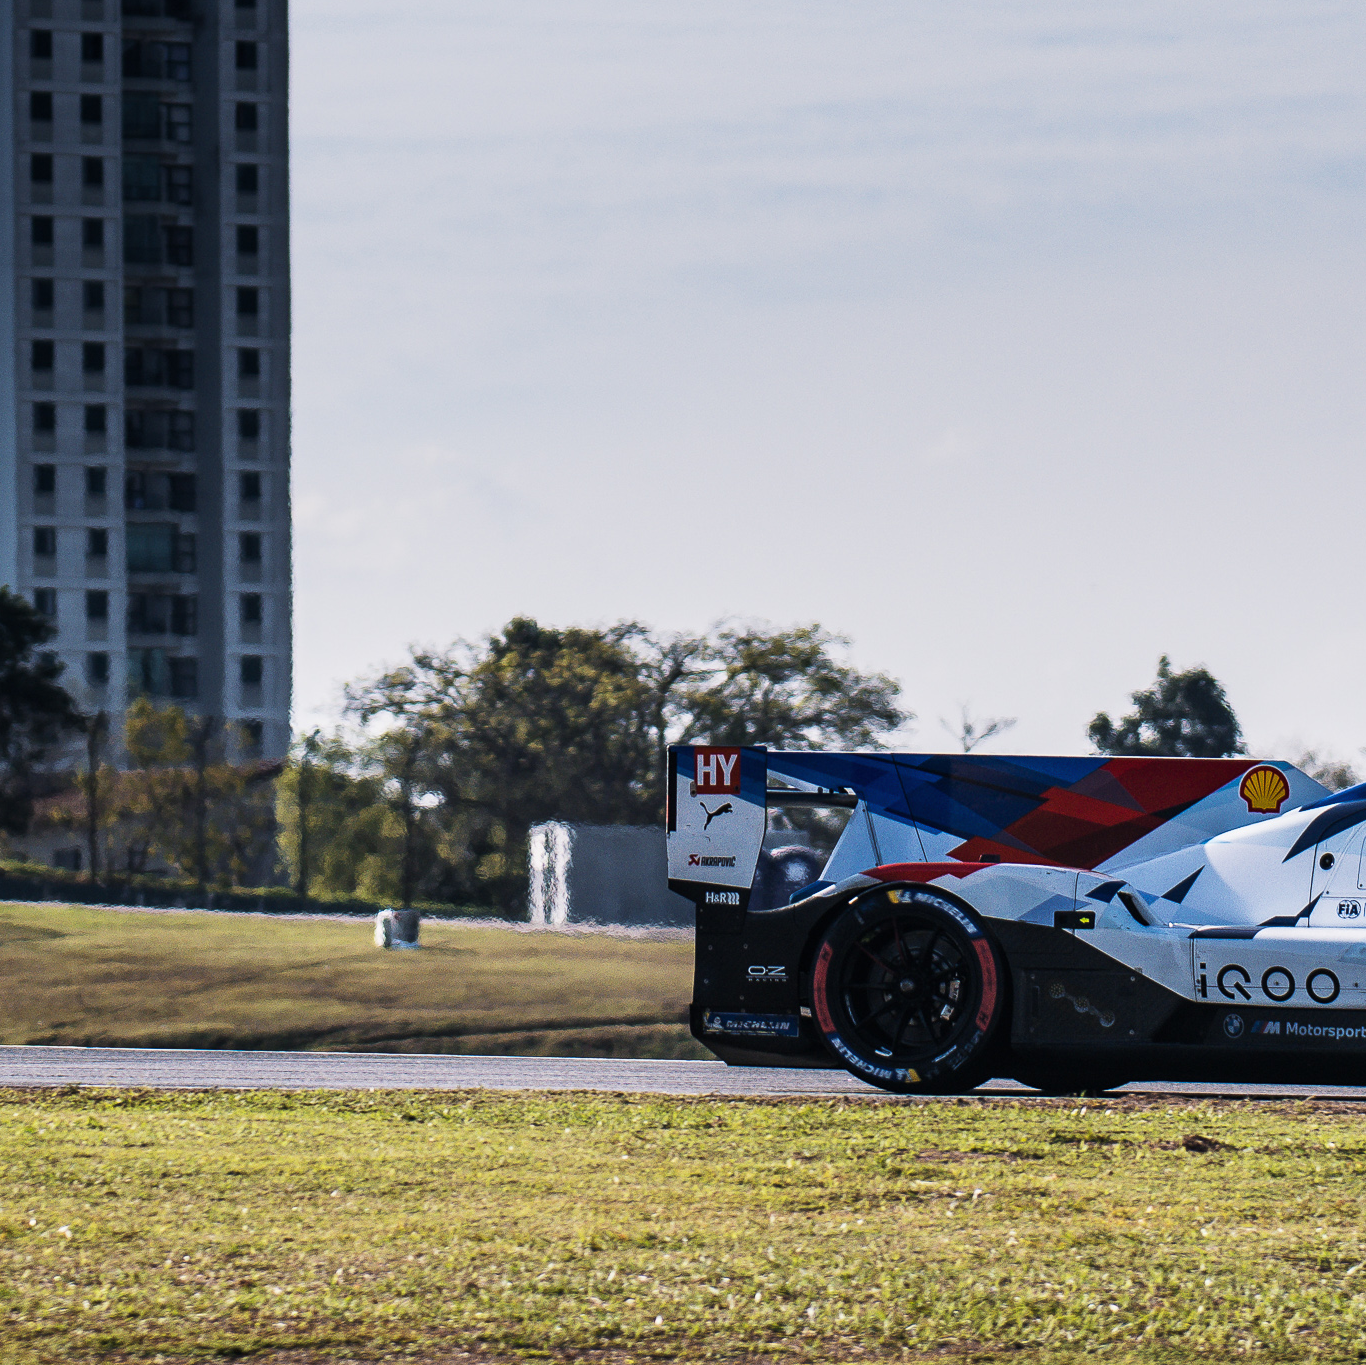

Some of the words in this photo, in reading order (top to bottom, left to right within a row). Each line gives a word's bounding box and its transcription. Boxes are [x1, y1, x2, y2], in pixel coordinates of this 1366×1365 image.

[697, 754, 738, 786] HY
[705, 891, 727, 903] H&R
[1286, 1022, 1366, 1039] Motorsport
